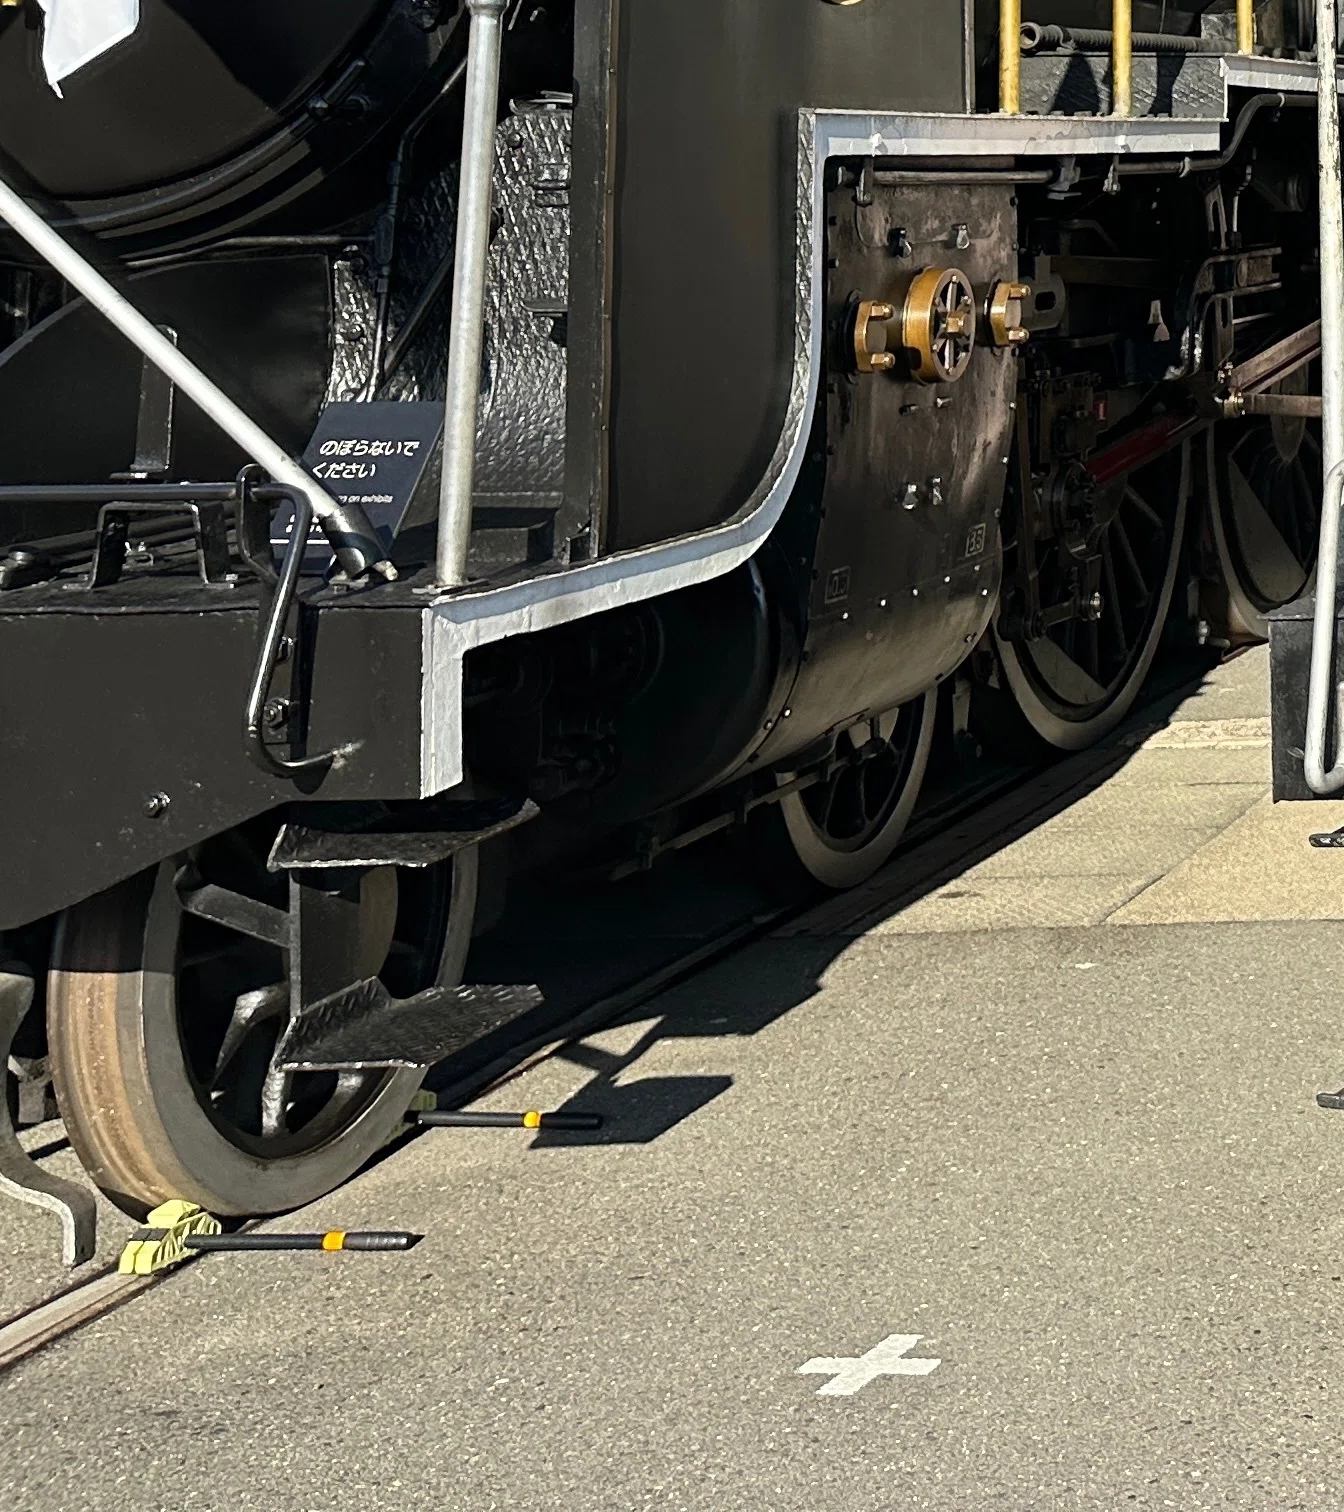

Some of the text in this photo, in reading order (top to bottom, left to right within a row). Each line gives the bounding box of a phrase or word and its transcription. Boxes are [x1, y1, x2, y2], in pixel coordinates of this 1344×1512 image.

[319, 439, 420, 456] のぼらないで
[312, 462, 376, 479] ください
